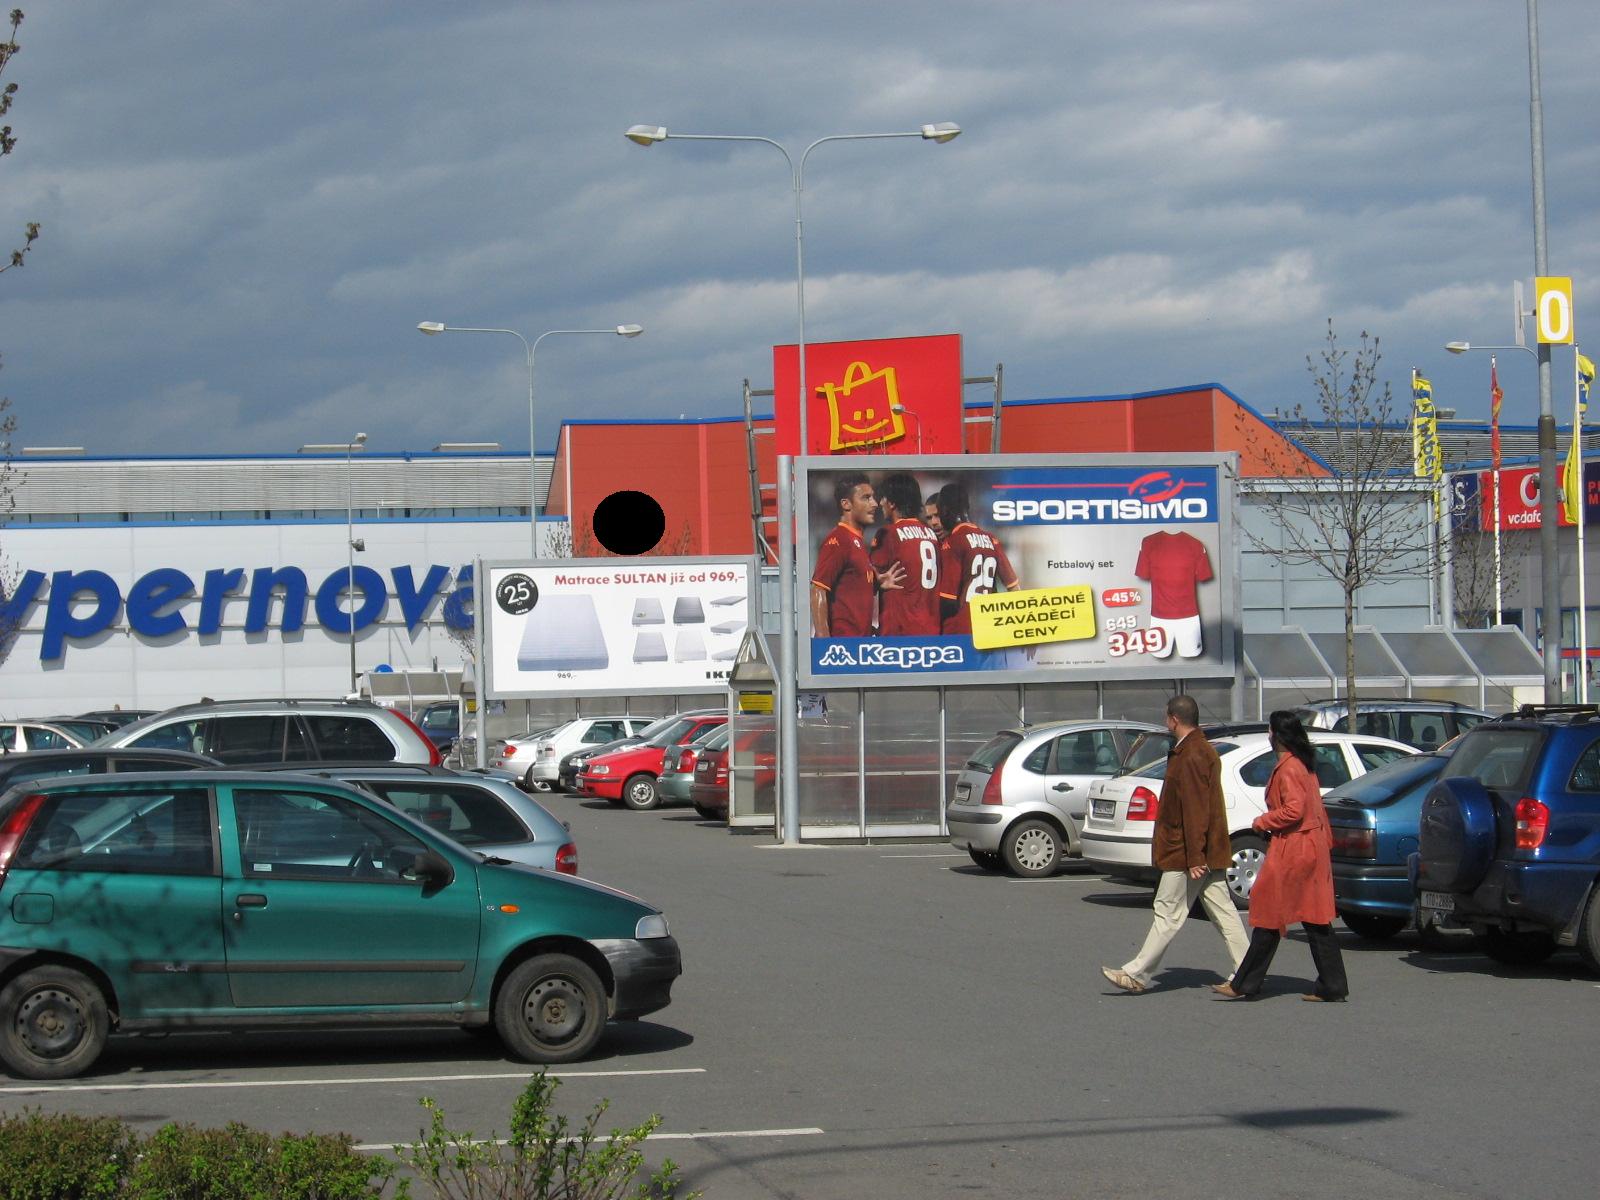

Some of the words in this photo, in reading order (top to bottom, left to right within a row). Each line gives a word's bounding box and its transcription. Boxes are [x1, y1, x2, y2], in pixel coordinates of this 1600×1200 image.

[920, 540, 937, 589] 8
[1047, 560, 1095, 570] Fotbalový
[1098, 560, 1114, 568] set
[554, 575, 610, 585] Matrace
[614, 573, 667, 584] SULTAN
[670, 572, 685, 586] již
[689, 572, 706, 583] od
[504, 581, 530, 604] 25
[980, 592, 1086, 613] MIMOŘÁDNÉ
[993, 607, 1076, 626] ZAVÁDĚCÍ
[1105, 615, 1138, 631] 649
[1013, 626, 1058, 639] CENY
[1107, 628, 1165, 657] 349
[859, 644, 964, 668] Kappa
